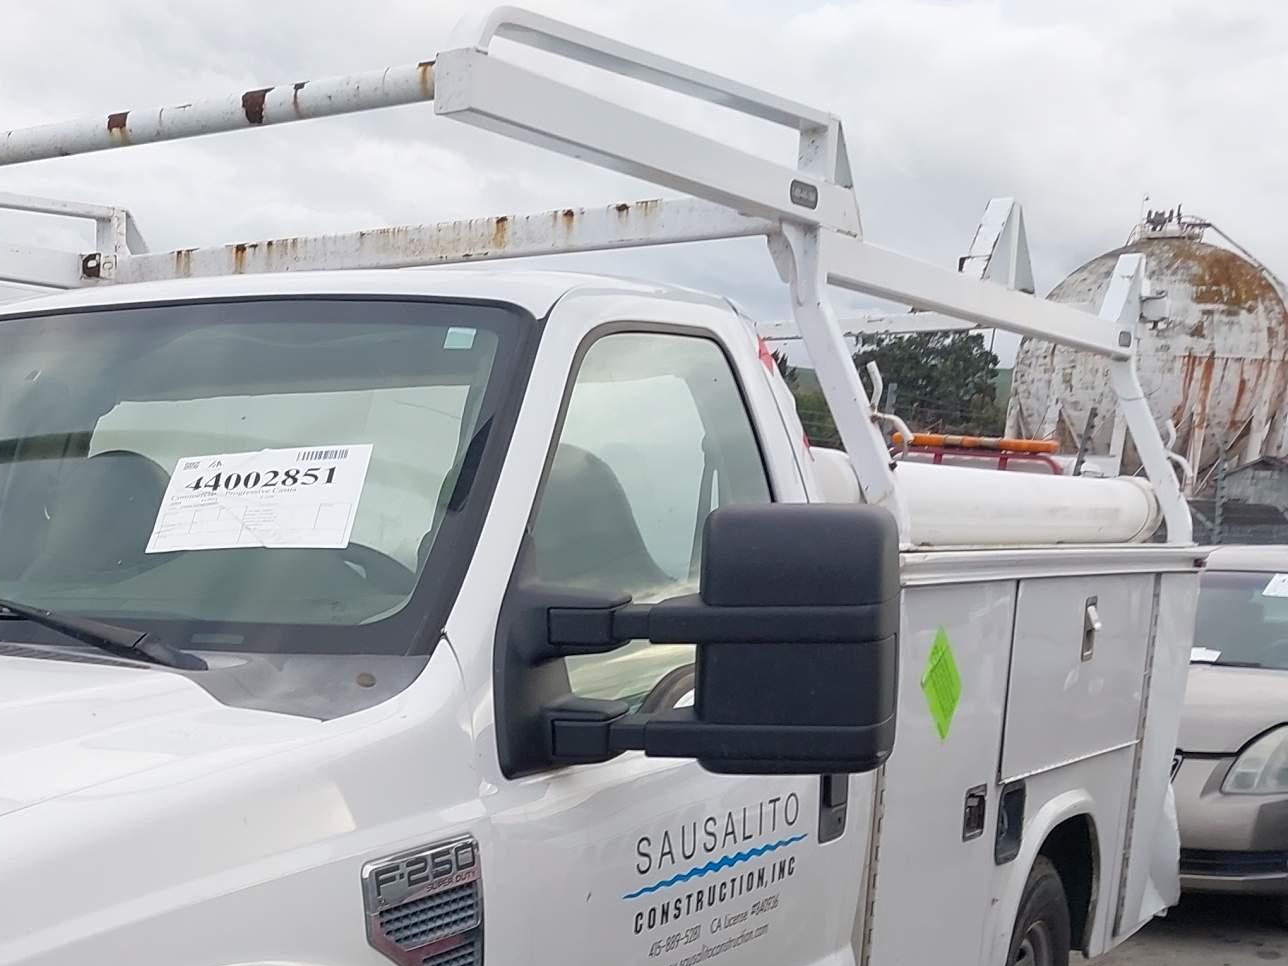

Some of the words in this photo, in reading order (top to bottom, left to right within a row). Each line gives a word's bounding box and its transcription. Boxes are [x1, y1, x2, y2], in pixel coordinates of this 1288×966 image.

[185, 467, 337, 491] 44002851
[636, 792, 800, 875] SAUSALITO
[374, 843, 476, 898] F-250
[710, 917, 722, 934] CA
[724, 910, 748, 928] License
